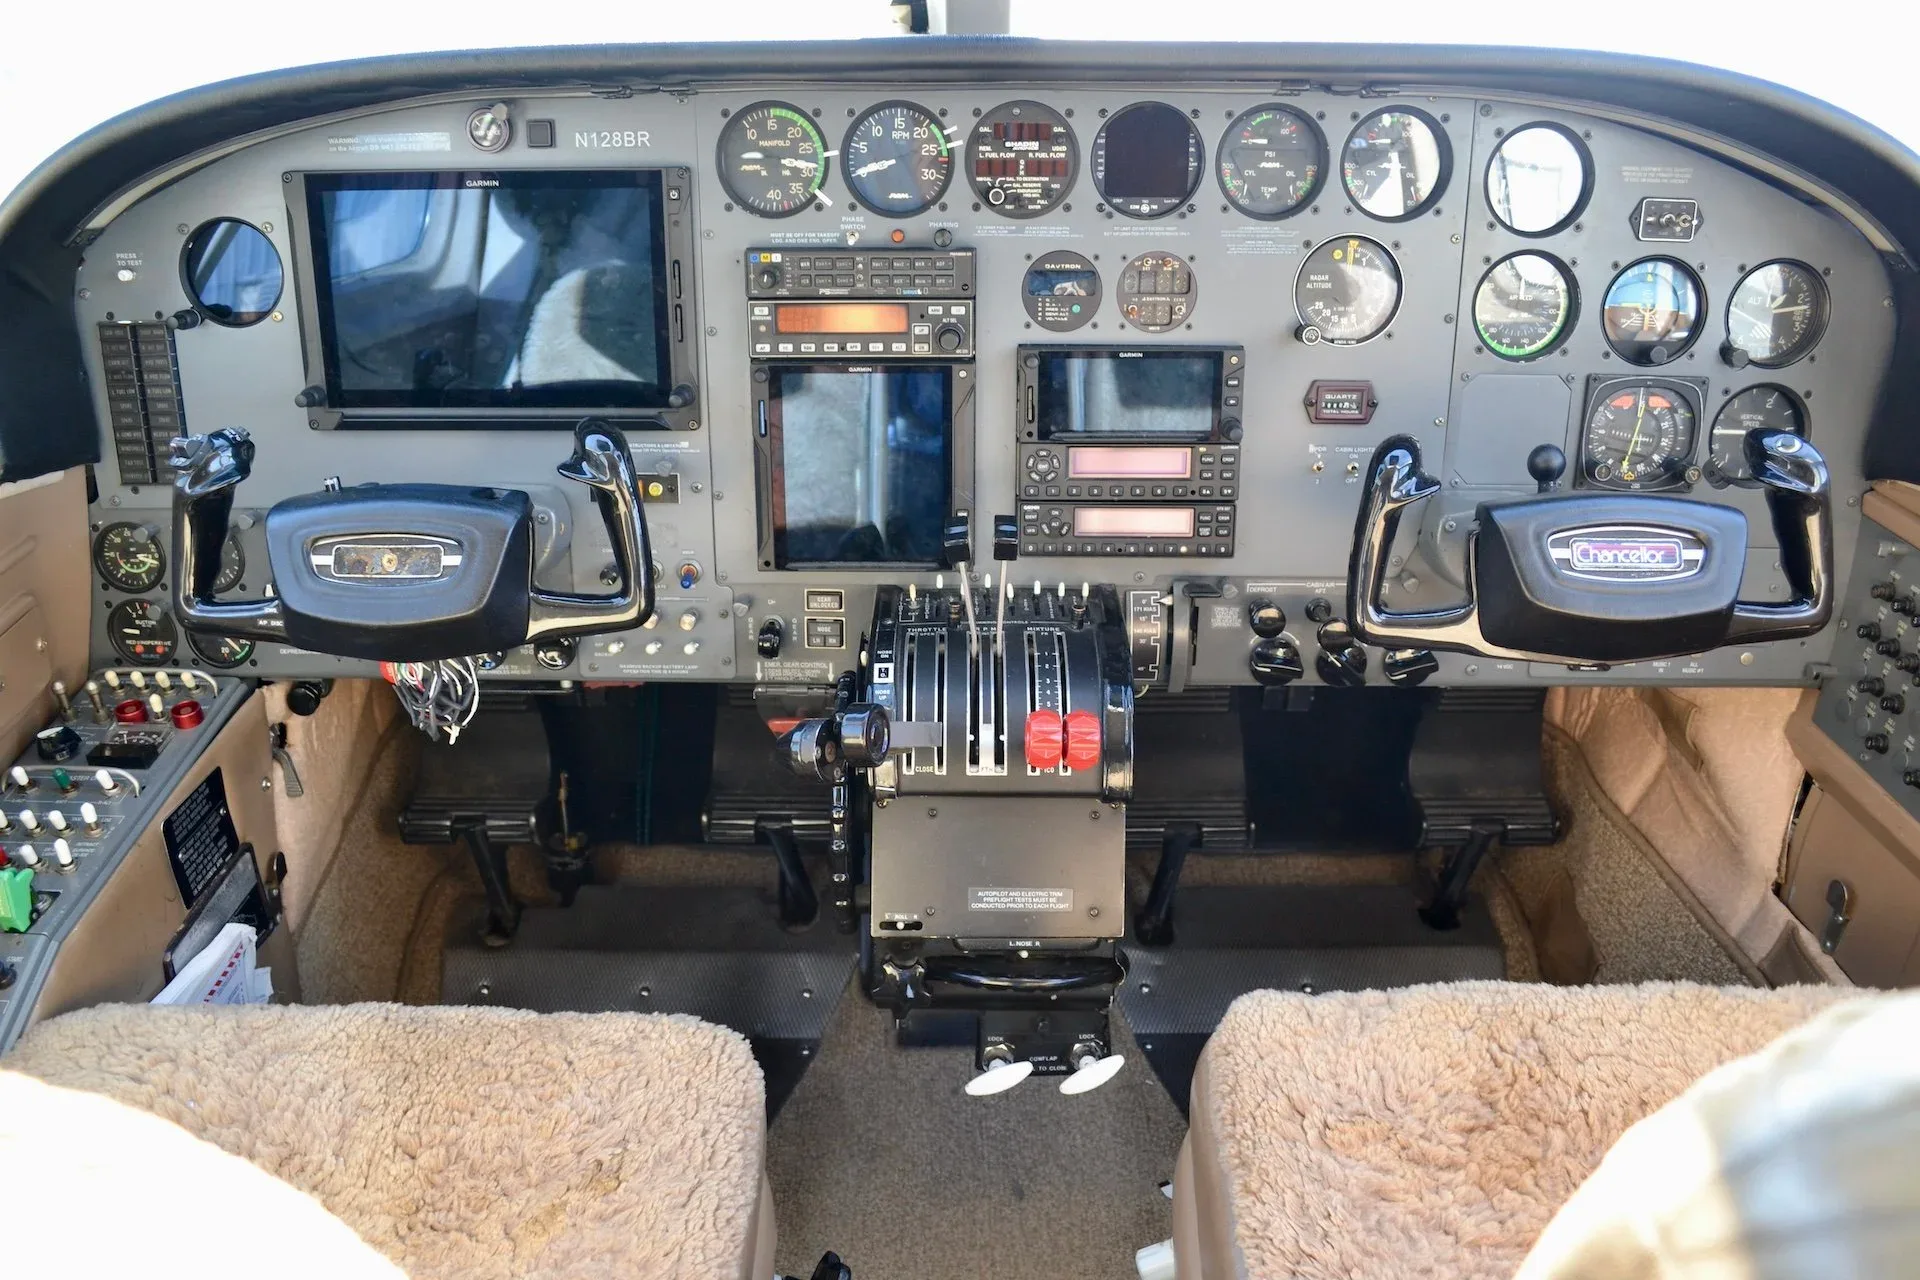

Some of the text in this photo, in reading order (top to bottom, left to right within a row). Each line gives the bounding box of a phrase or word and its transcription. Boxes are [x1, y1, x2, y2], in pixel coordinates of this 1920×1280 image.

[767, 119, 778, 131] 15
[895, 118, 905, 129] 15
[746, 129, 757, 140] 10
[788, 127, 802, 139] 20
[872, 126, 883, 137] 10
[892, 131, 909, 140] RPM
[913, 127, 929, 138] 20
[575, 132, 651, 148] N128BR
[799, 143, 813, 154] 25
[859, 142, 868, 153] 5
[922, 145, 938, 156] 25
[801, 167, 814, 178] 30
[921, 169, 936, 180] 30
[789, 183, 804, 194] 35
[767, 190, 782, 201] 40
[1748, 296, 1762, 305] ALT
[1797, 293, 1804, 304] 2
[1315, 302, 1323, 310] 25
[1322, 309, 1331, 317] 20
[1765, 399, 1774, 409] 2
[1576, 543, 1665, 563] Chancellor
